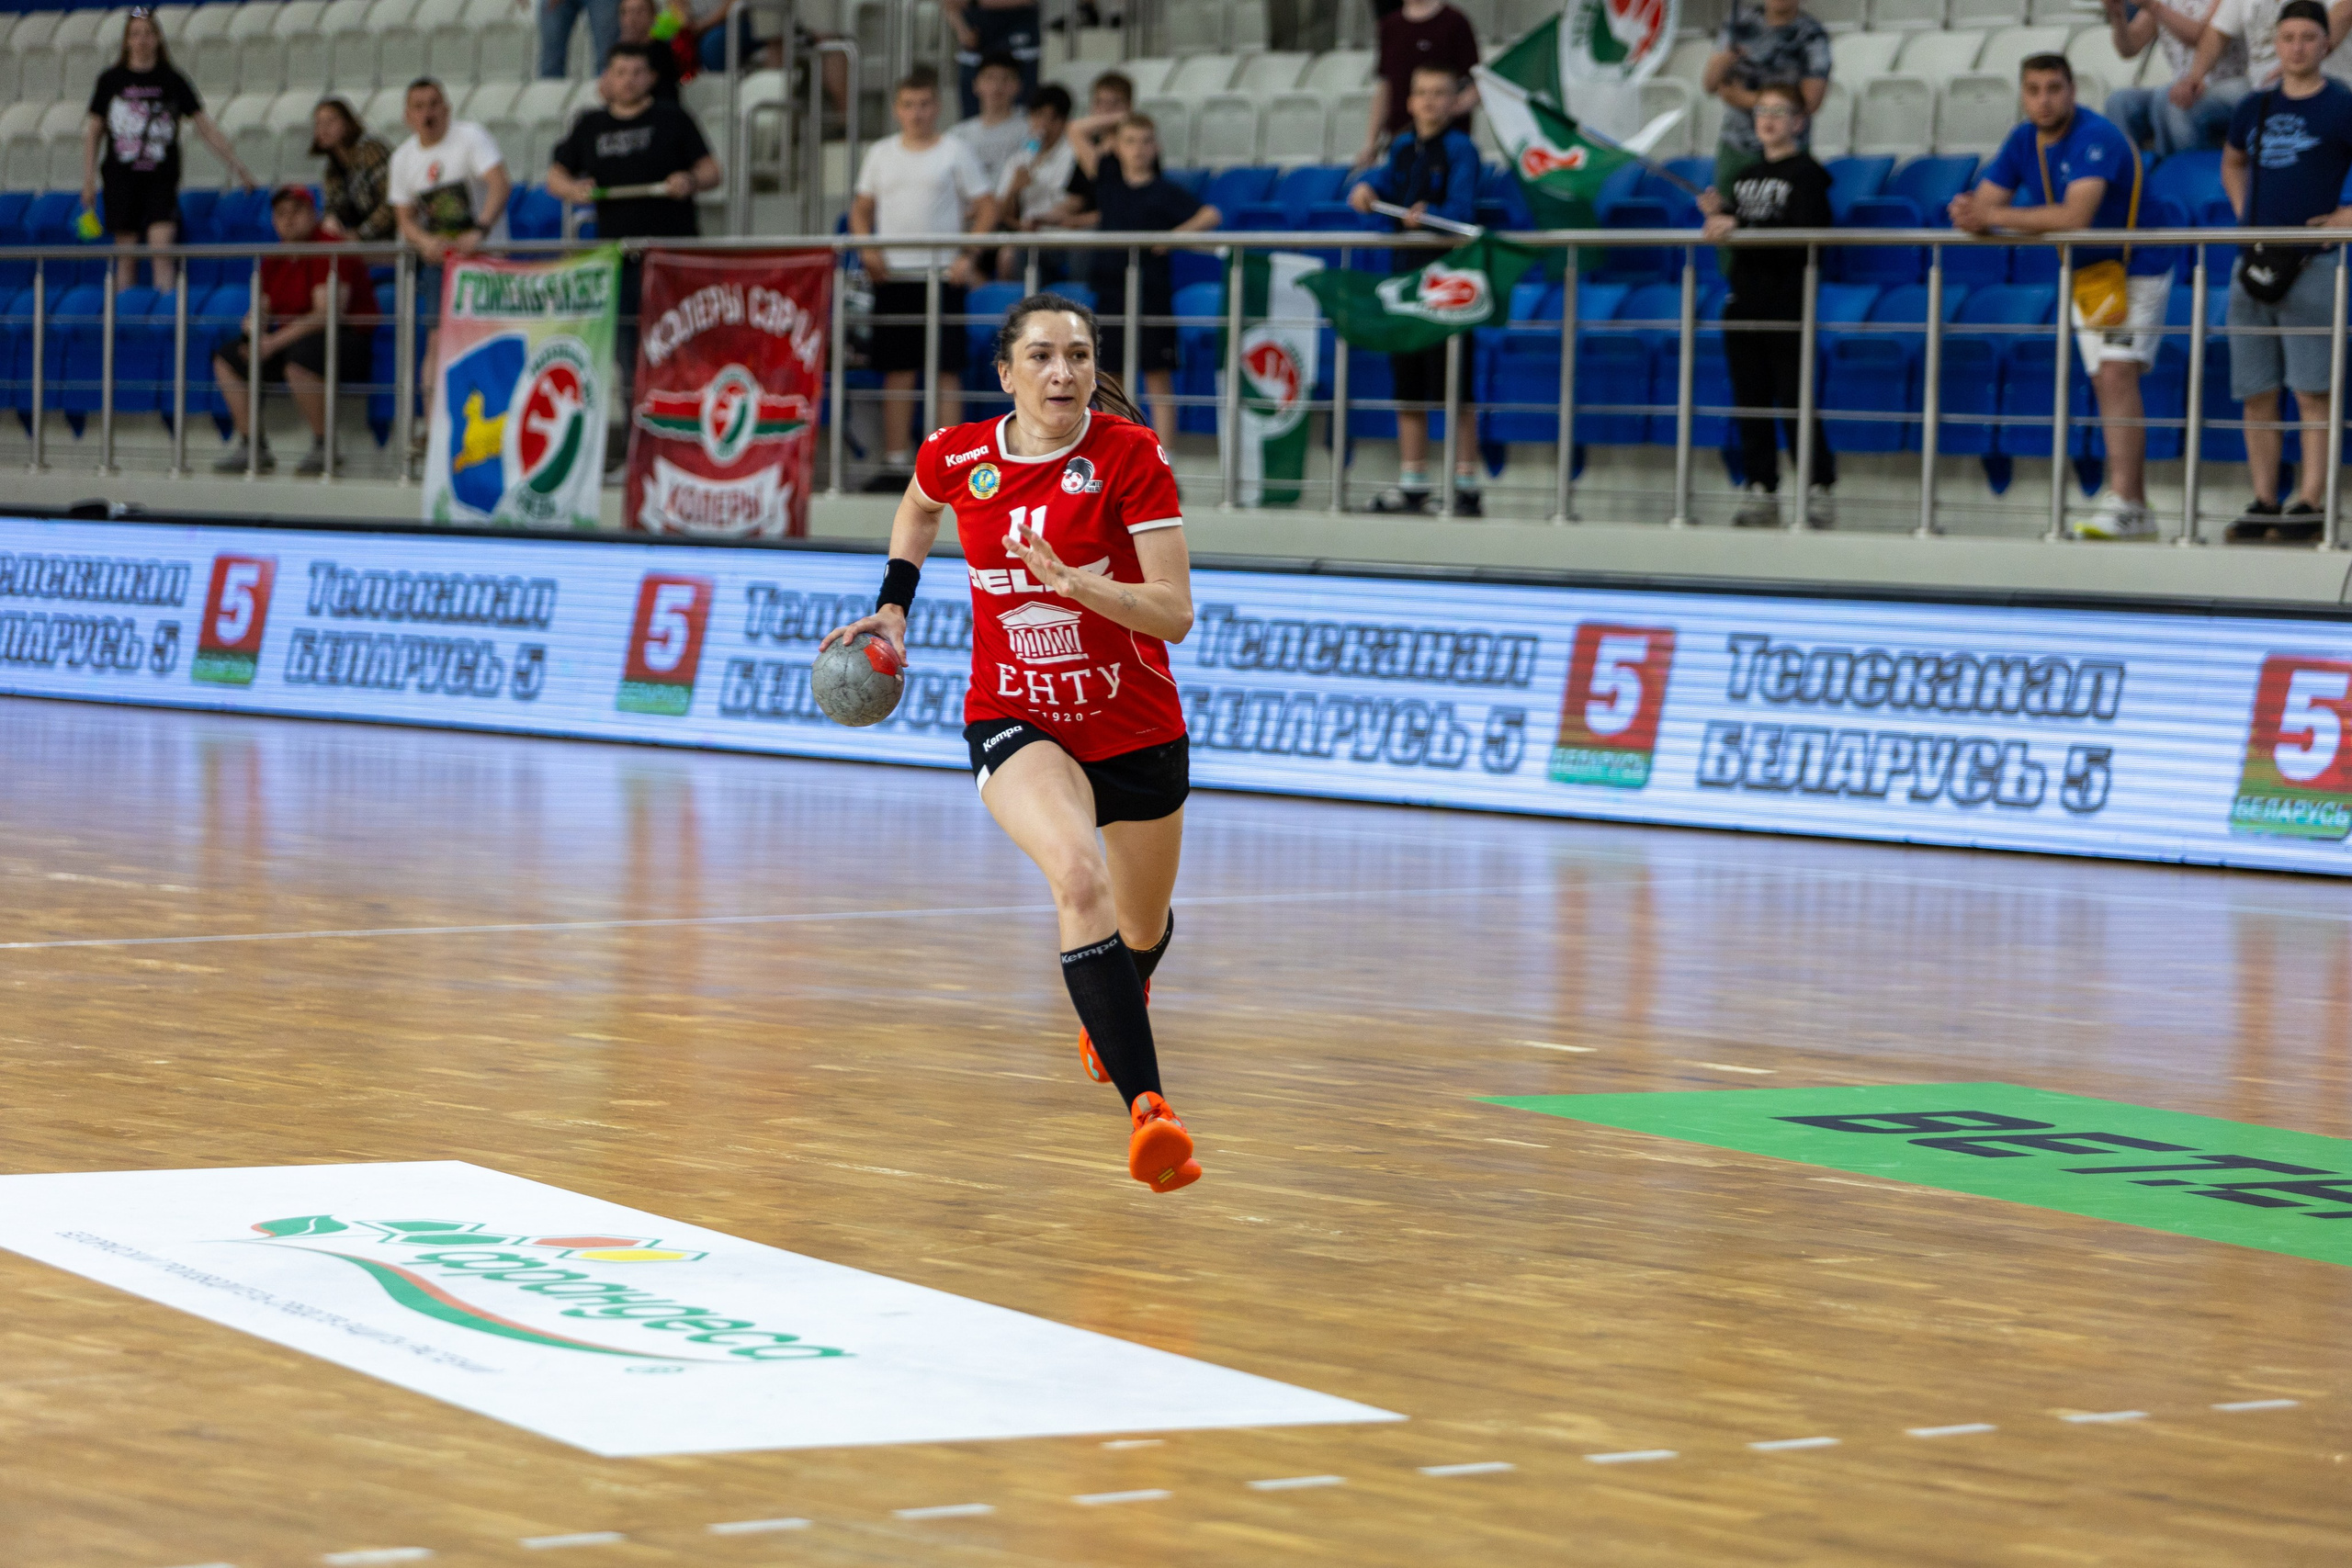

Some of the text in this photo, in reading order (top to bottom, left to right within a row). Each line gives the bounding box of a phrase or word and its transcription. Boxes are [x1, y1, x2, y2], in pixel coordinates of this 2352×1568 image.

[944, 445, 989, 468] Kempa
[1005, 504, 1047, 558] 11
[0, 553, 191, 607] елеканал
[216, 562, 261, 642] 5
[149, 619, 181, 674] 5
[643, 582, 696, 673] 5
[1198, 604, 1538, 689] Телеканал
[510, 642, 548, 701] 5
[1584, 634, 1651, 737] 5
[1726, 632, 2126, 720] Телеканал
[982, 725, 1023, 752] Kempa
[1183, 684, 1526, 774] БЕЛАРУСЬ 5
[2273, 668, 2352, 781] 5
[1695, 719, 2113, 815] БЕЛАРУСЬ 5
[1060, 937, 1118, 965] Kempa
